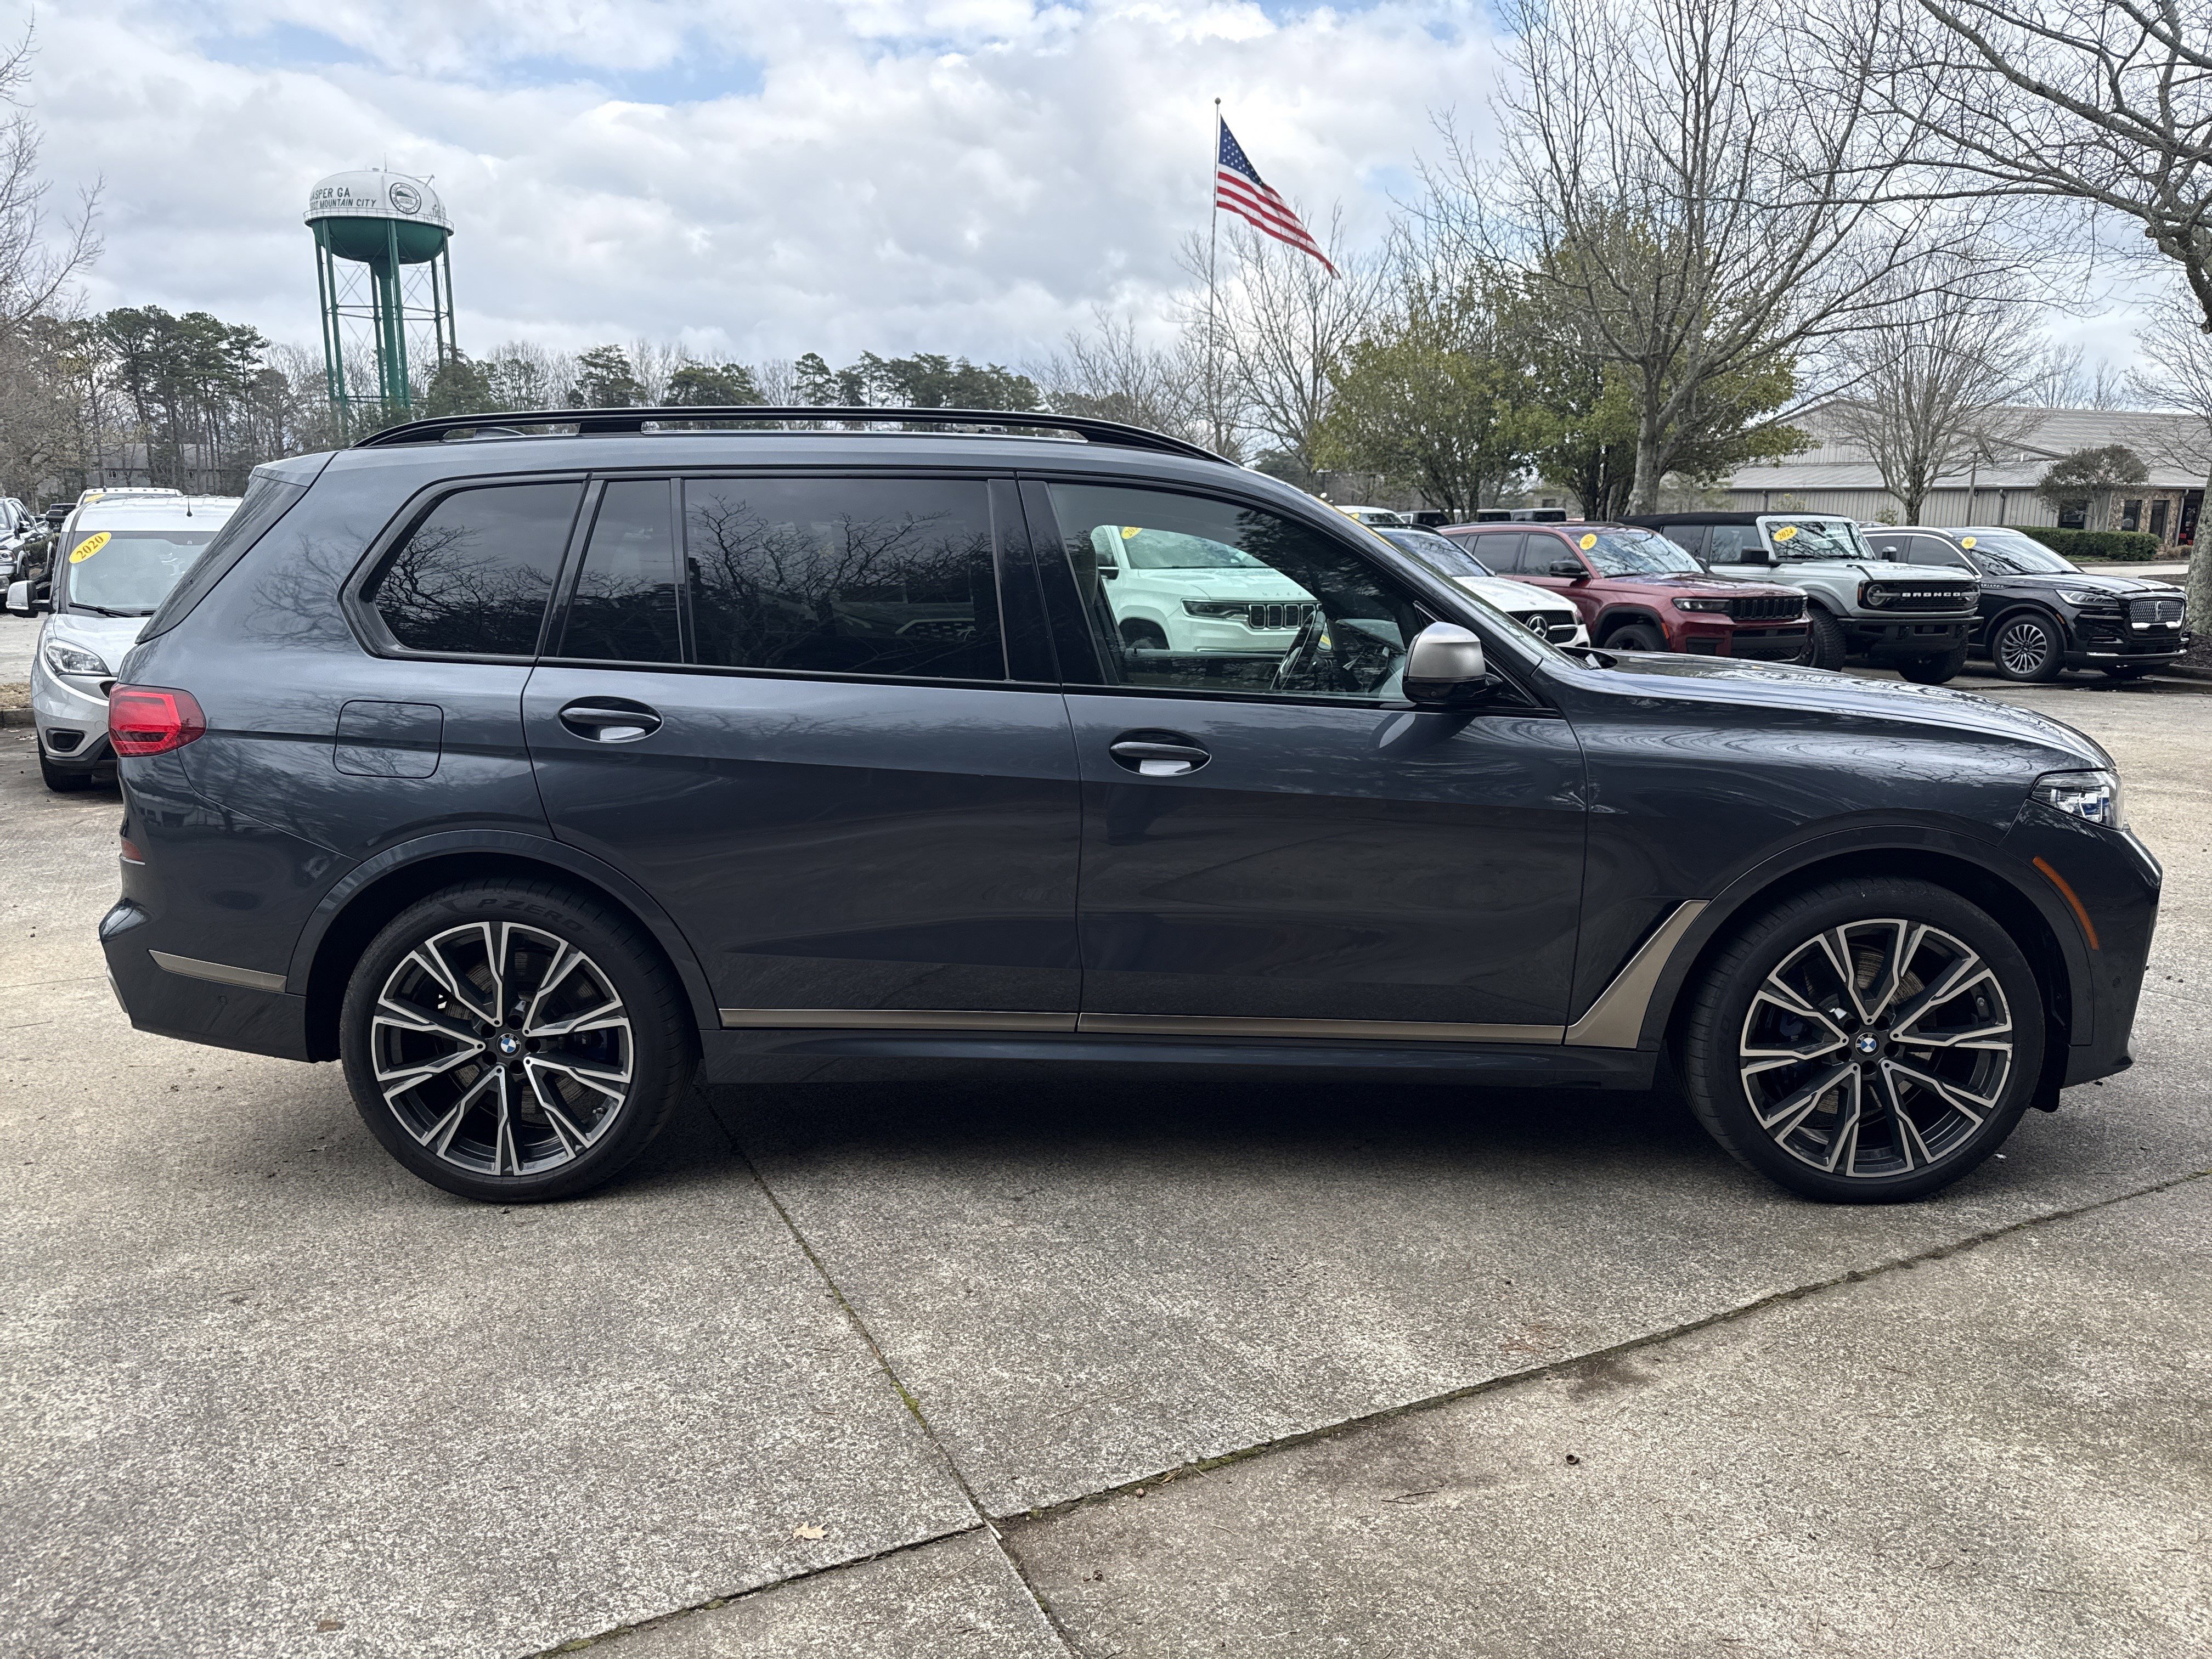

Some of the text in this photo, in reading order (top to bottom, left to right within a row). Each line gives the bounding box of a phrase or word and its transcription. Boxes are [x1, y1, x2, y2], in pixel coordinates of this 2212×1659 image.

[337, 187, 351, 198] GA
[320, 199, 353, 208] MOUNTAIN
[356, 199, 376, 207] CITY
[1778, 527, 1793, 540] 2024
[77, 535, 104, 559] 2020
[502, 900, 585, 932] ZERO
